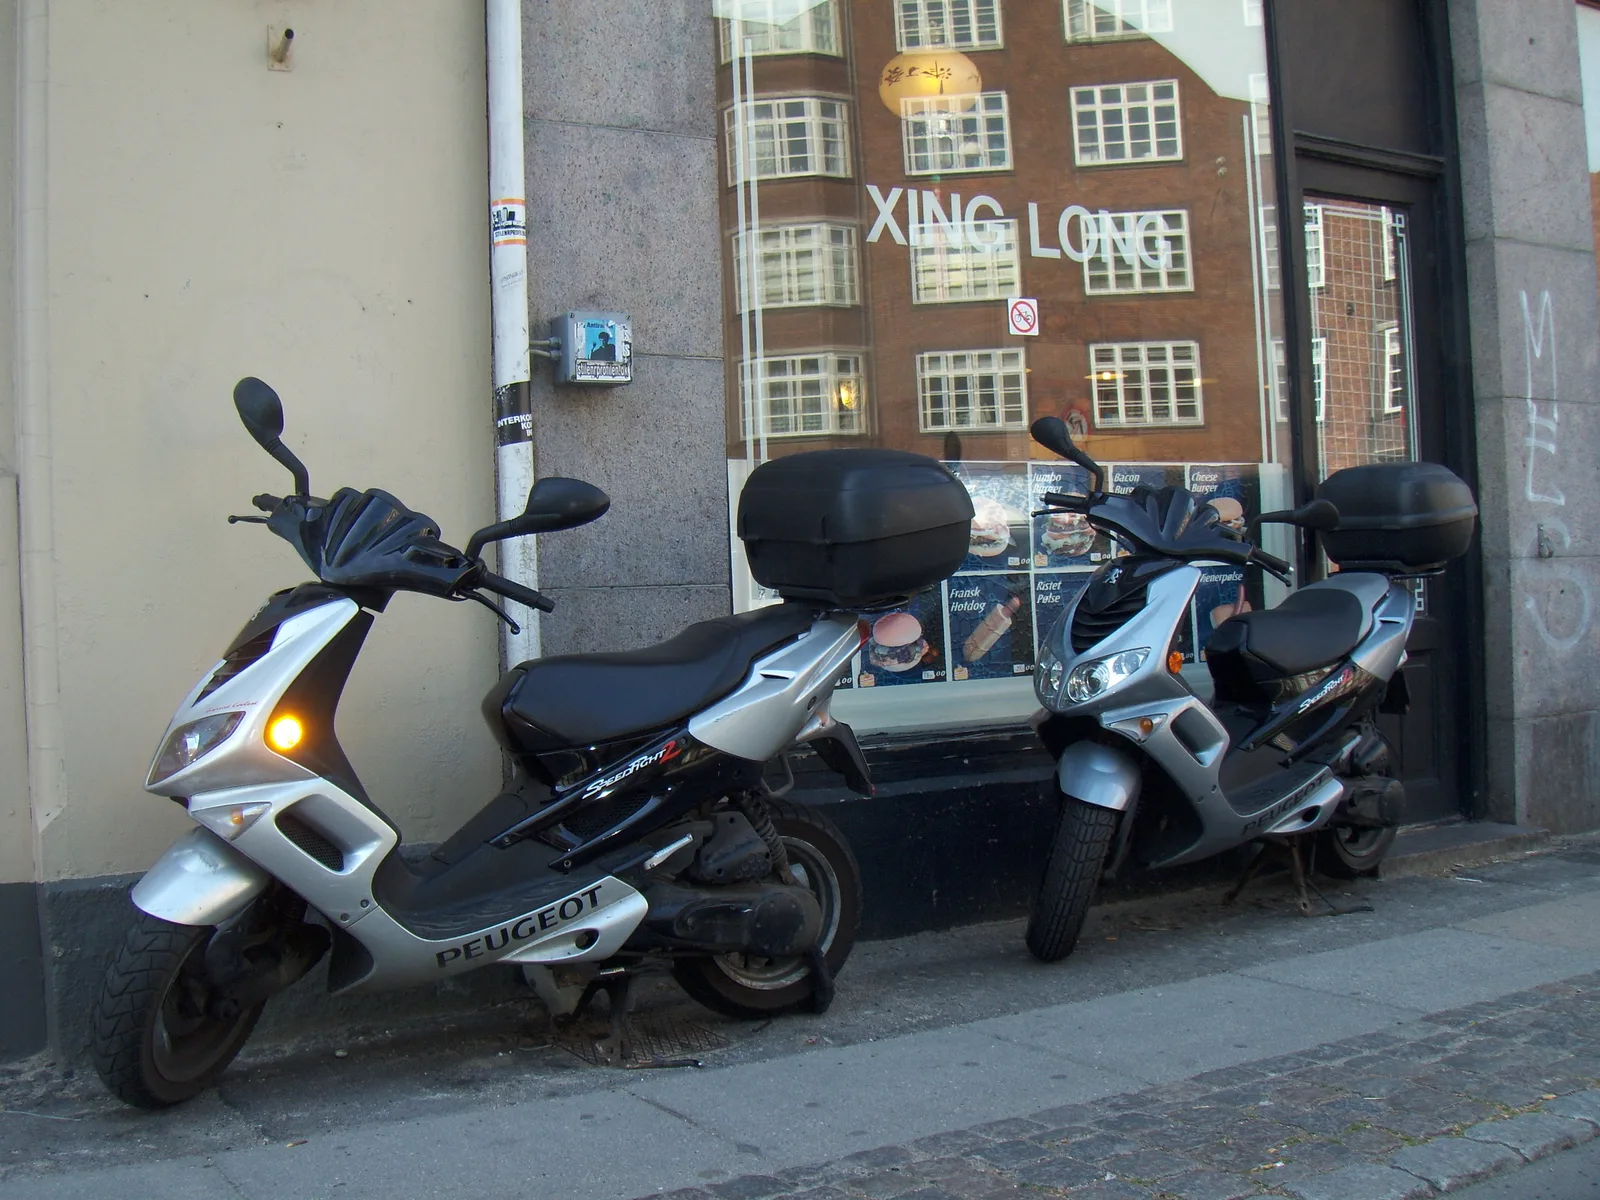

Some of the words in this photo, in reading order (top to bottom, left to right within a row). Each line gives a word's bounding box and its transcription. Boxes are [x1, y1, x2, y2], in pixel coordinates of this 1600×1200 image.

[866, 184, 1005, 255] XING
[1028, 202, 1173, 269] LONG
[1033, 472, 1062, 482] Jumbo
[1113, 472, 1140, 483] Bacon
[1191, 471, 1218, 482] Cheese
[1032, 484, 1062, 493] Burger
[1191, 483, 1218, 495] Burger
[1036, 581, 1062, 591] Ristet
[949, 586, 981, 599] Fransk
[1036, 592, 1061, 604] Pølse
[950, 600, 986, 613] Hotdog
[435, 884, 602, 968] PEUGEOT
